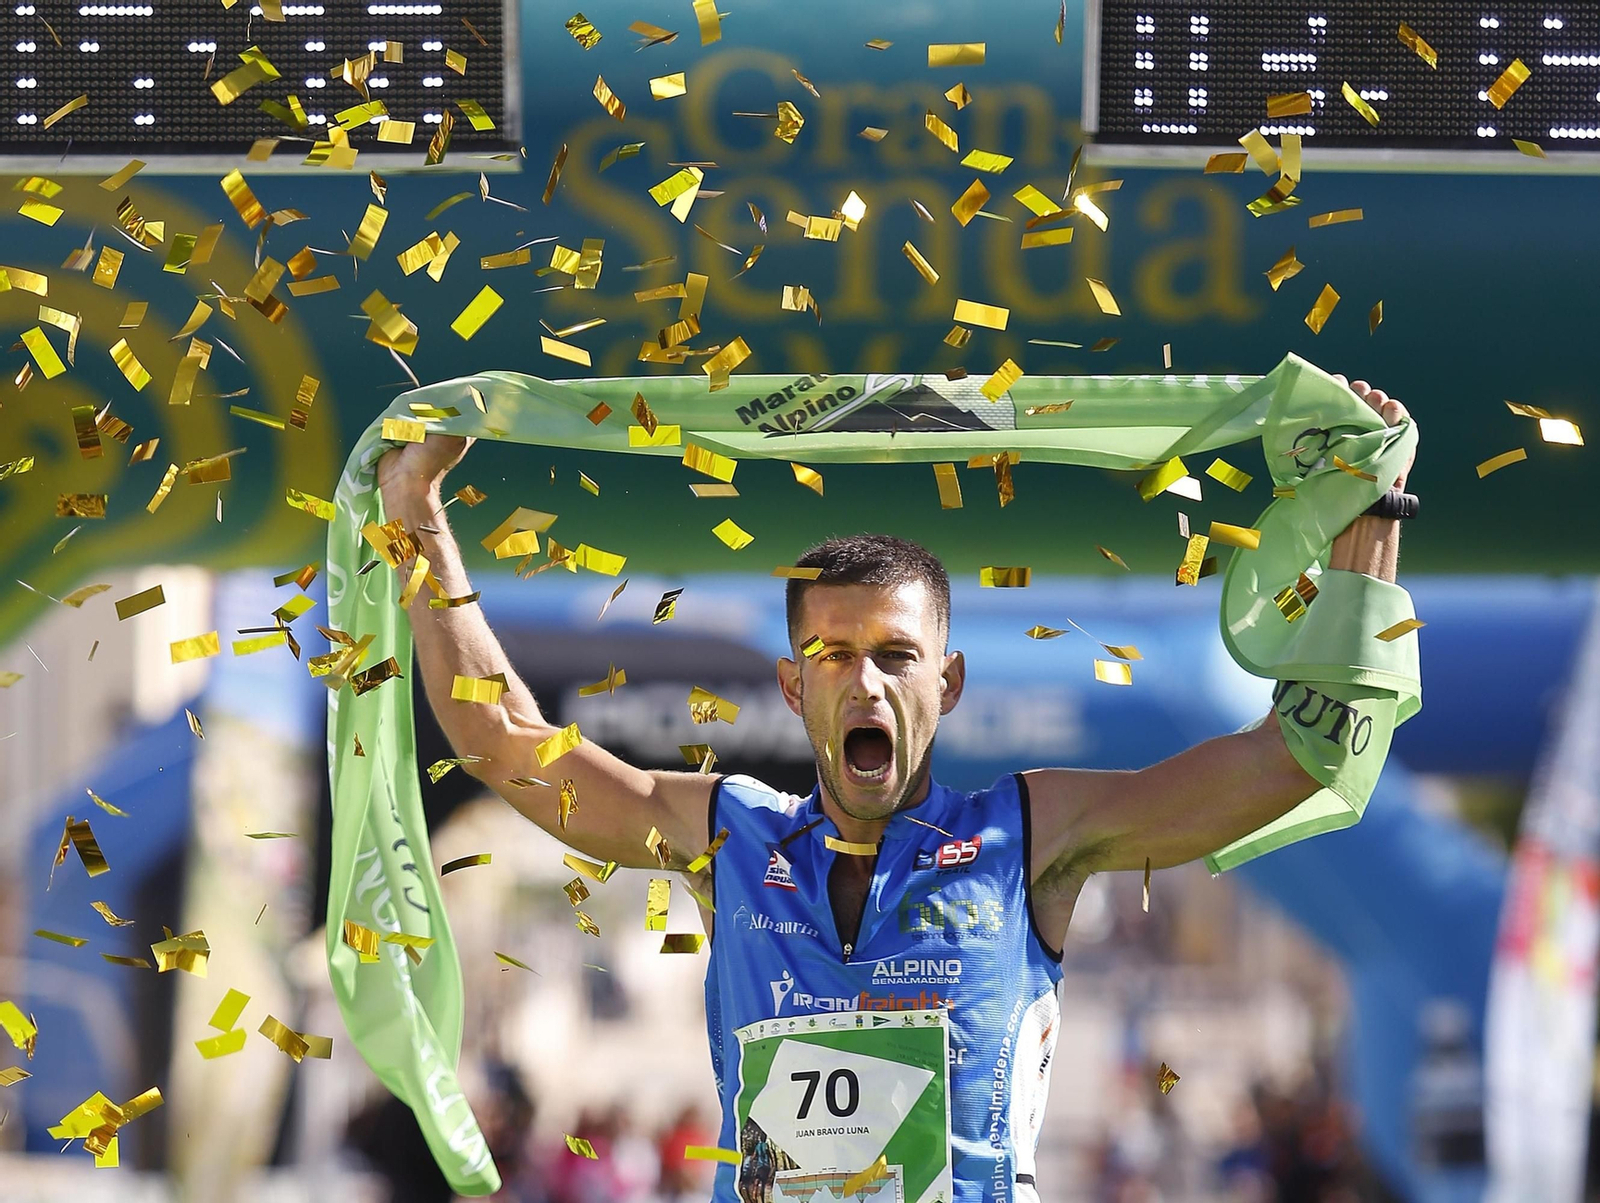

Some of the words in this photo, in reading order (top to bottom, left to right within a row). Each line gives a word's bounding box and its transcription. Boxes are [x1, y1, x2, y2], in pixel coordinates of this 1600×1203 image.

[757, 385, 856, 436] Alpino
[872, 959, 962, 978] ALPINO
[872, 977, 961, 985] BENALMADENA
[790, 1068, 860, 1120] 70
[795, 1129, 815, 1138] JUAN
[816, 1127, 845, 1137] BRAVO
[846, 1126, 870, 1135] LUNA
